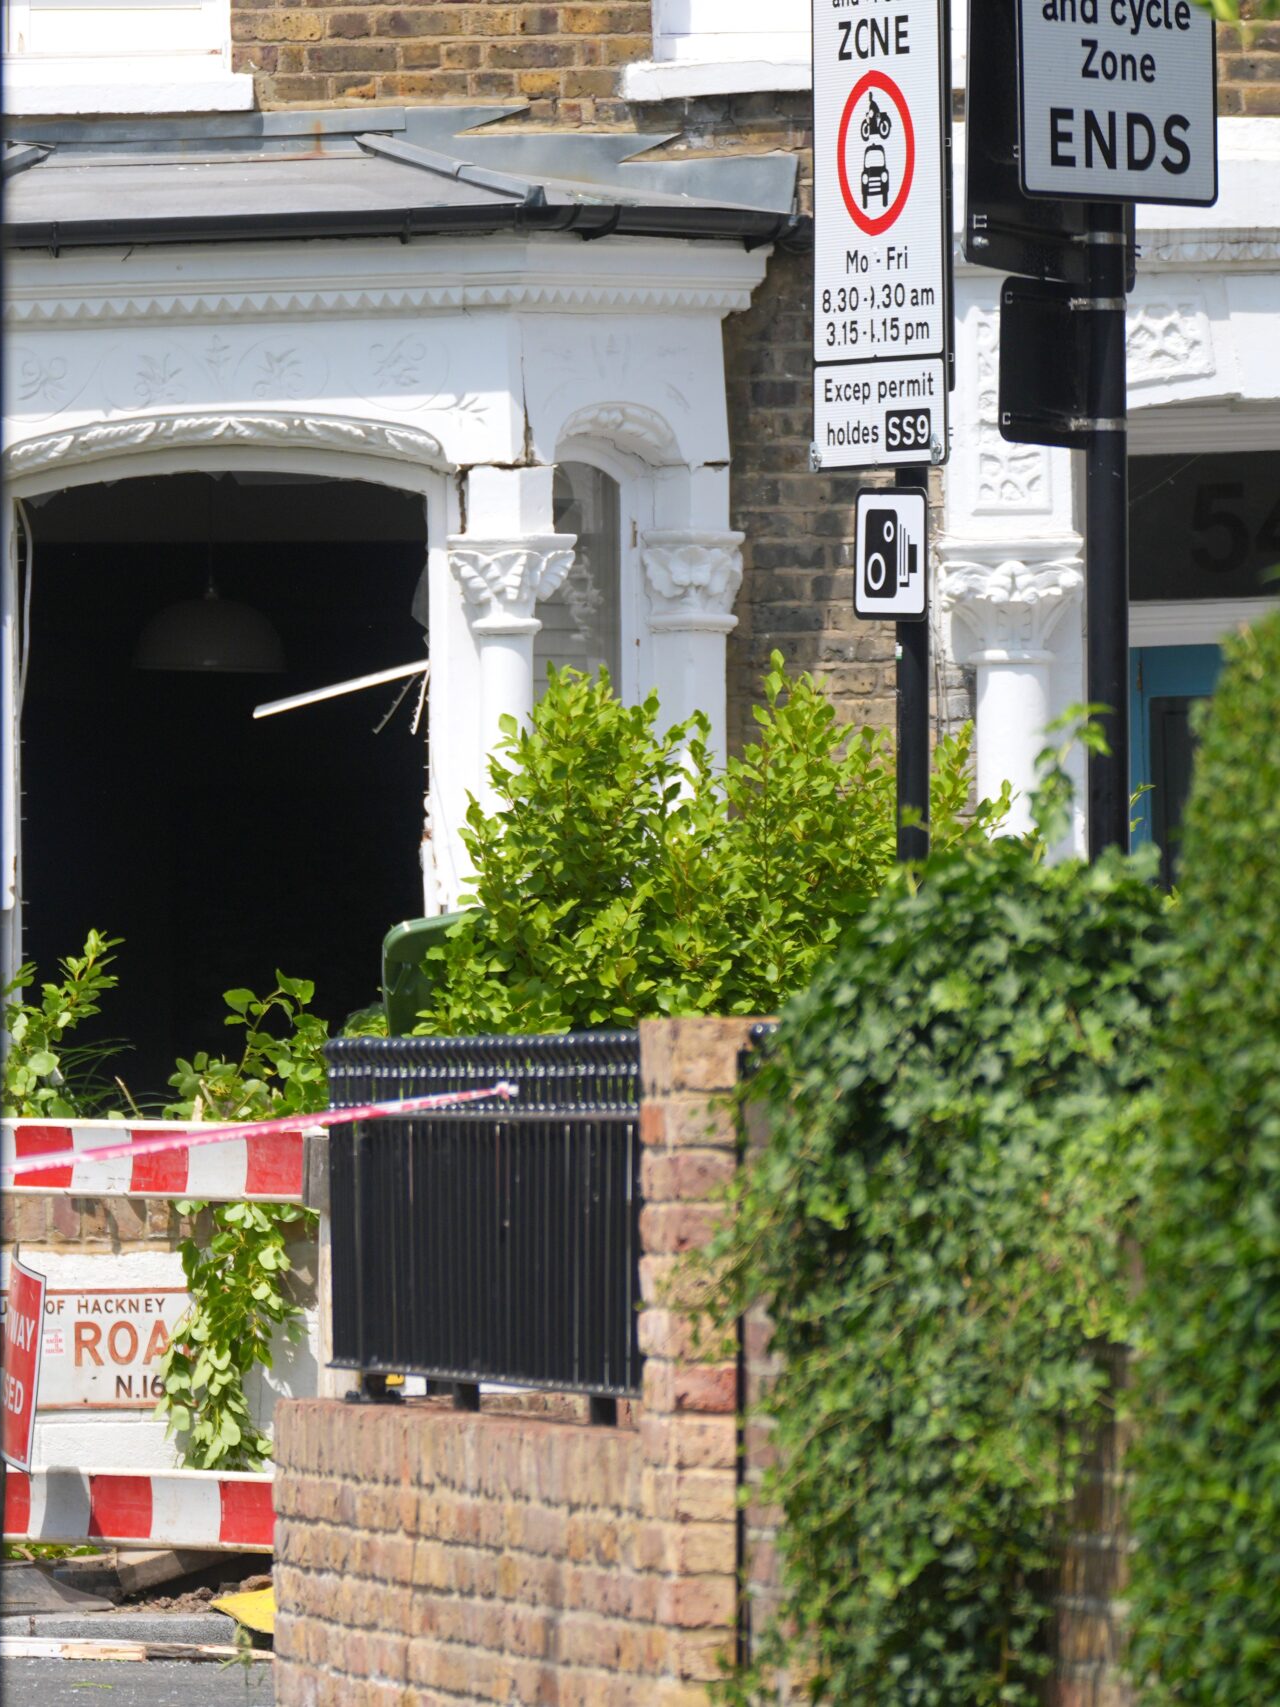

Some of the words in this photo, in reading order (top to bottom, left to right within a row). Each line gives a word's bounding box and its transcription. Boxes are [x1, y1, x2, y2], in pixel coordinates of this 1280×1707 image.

[1111, 0, 1191, 35] cycle
[1081, 38, 1156, 83] Zone
[1050, 107, 1191, 174] ENDS
[887, 246, 908, 270] Fri
[822, 286, 859, 313] 8.30
[910, 287, 934, 307] am
[826, 320, 858, 346] 3.15
[904, 321, 930, 345] pm
[878, 372, 934, 404] permit
[887, 414, 929, 447] SS9
[45, 1299, 65, 1315] OF
[77, 1298, 166, 1314] HACKNEY
[74, 1319, 178, 1366] ROA
[115, 1375, 168, 1398] N.16
